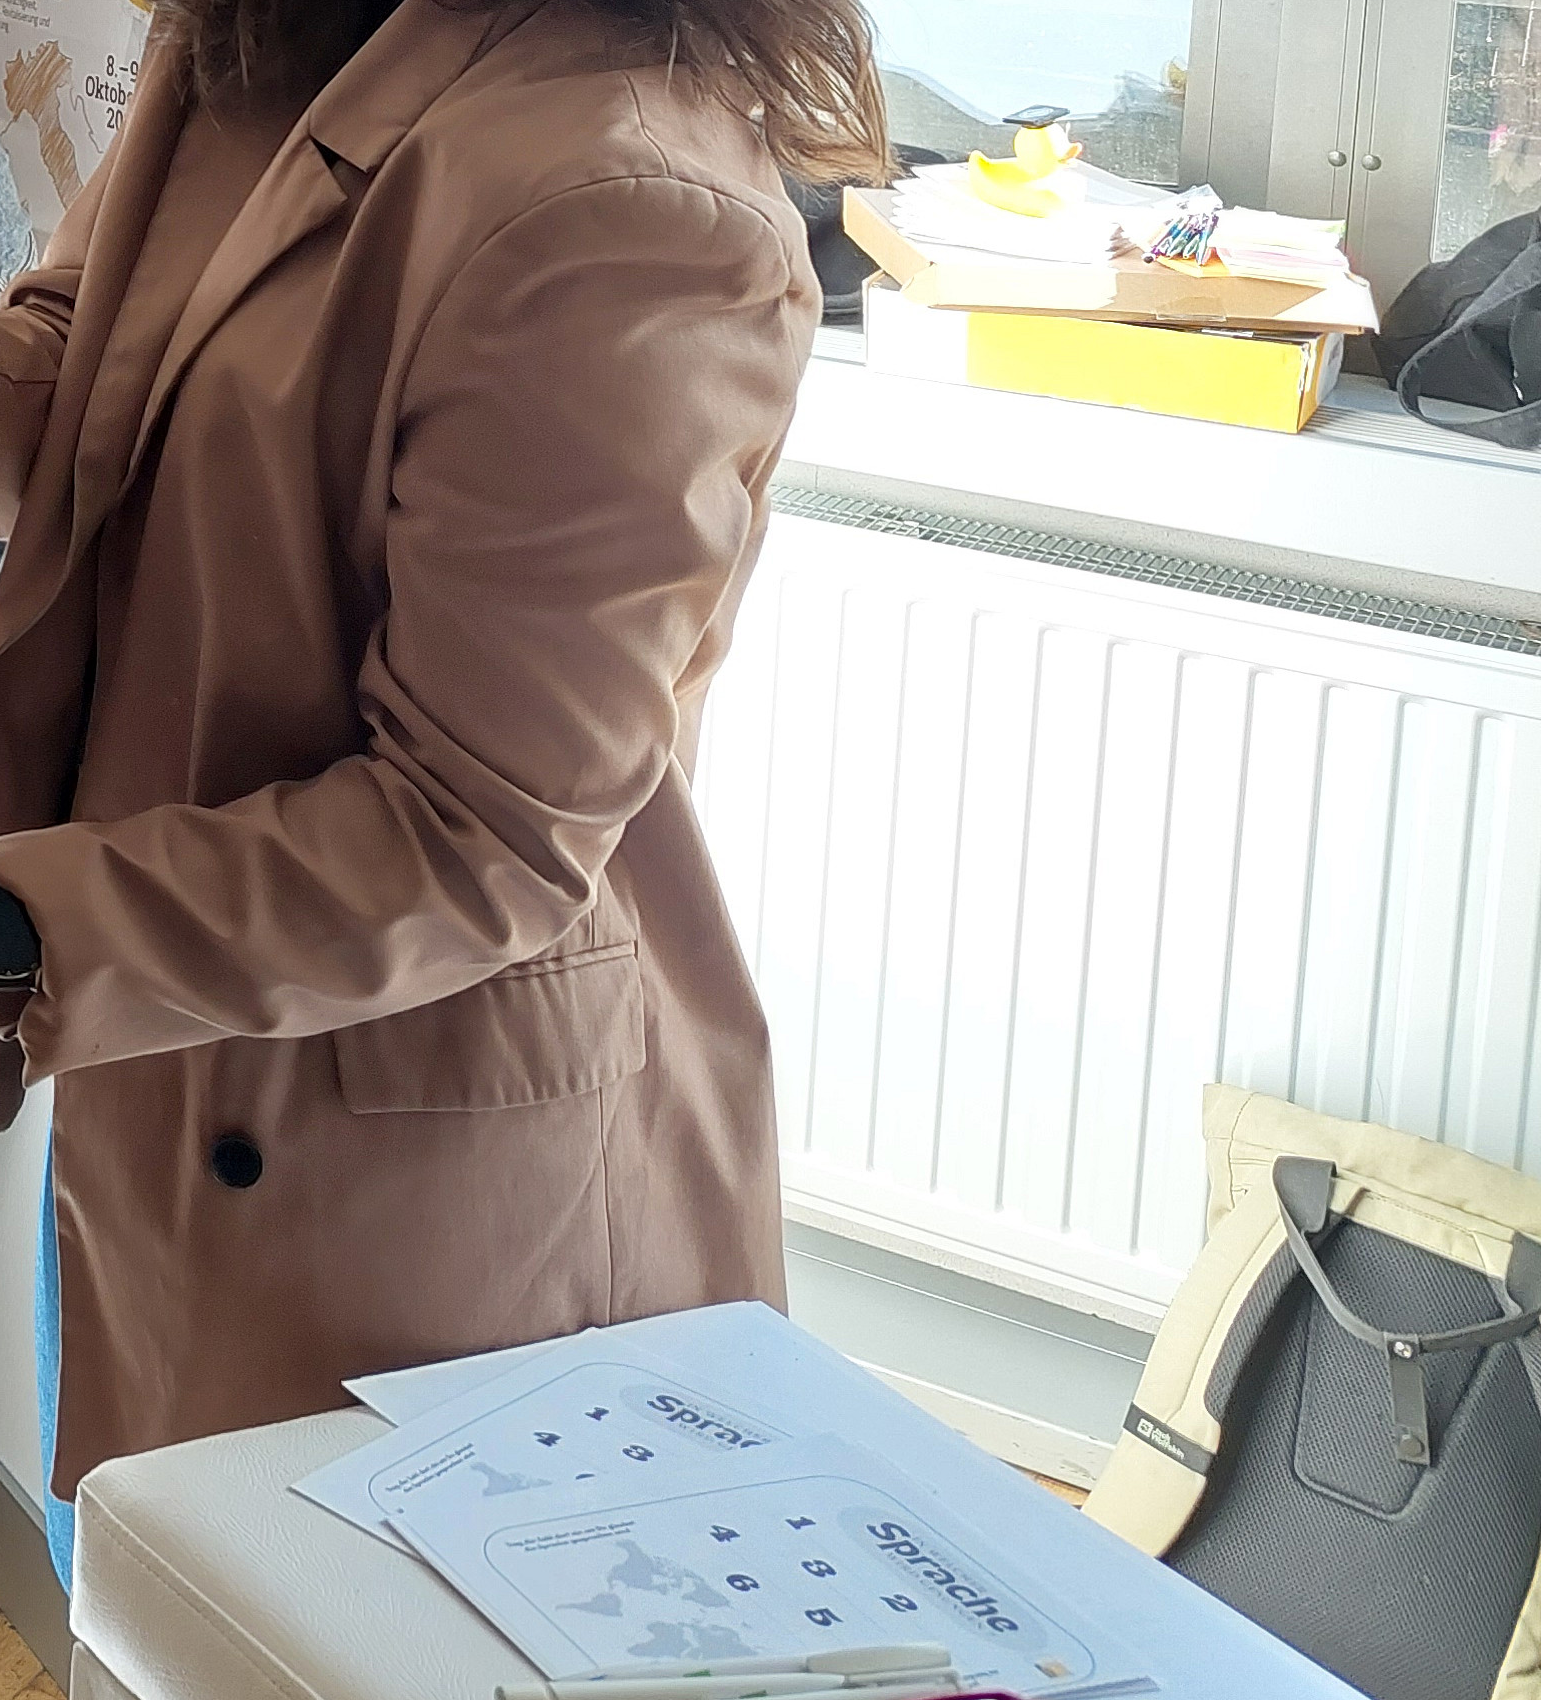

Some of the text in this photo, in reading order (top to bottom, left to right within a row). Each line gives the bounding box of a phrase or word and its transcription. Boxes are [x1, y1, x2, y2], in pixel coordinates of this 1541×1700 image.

[86, 76, 132, 105] Oktob
[585, 1407, 610, 1422] 1
[533, 1430, 562, 1447] 4
[622, 1444, 654, 1462] 3
[785, 1516, 816, 1530] 1
[710, 1524, 740, 1543] 4
[801, 1559, 837, 1578] 3
[867, 1522, 1019, 1633] Sprache
[726, 1574, 760, 1592] 6
[879, 1593, 918, 1612] 2
[805, 1607, 843, 1627] 5
